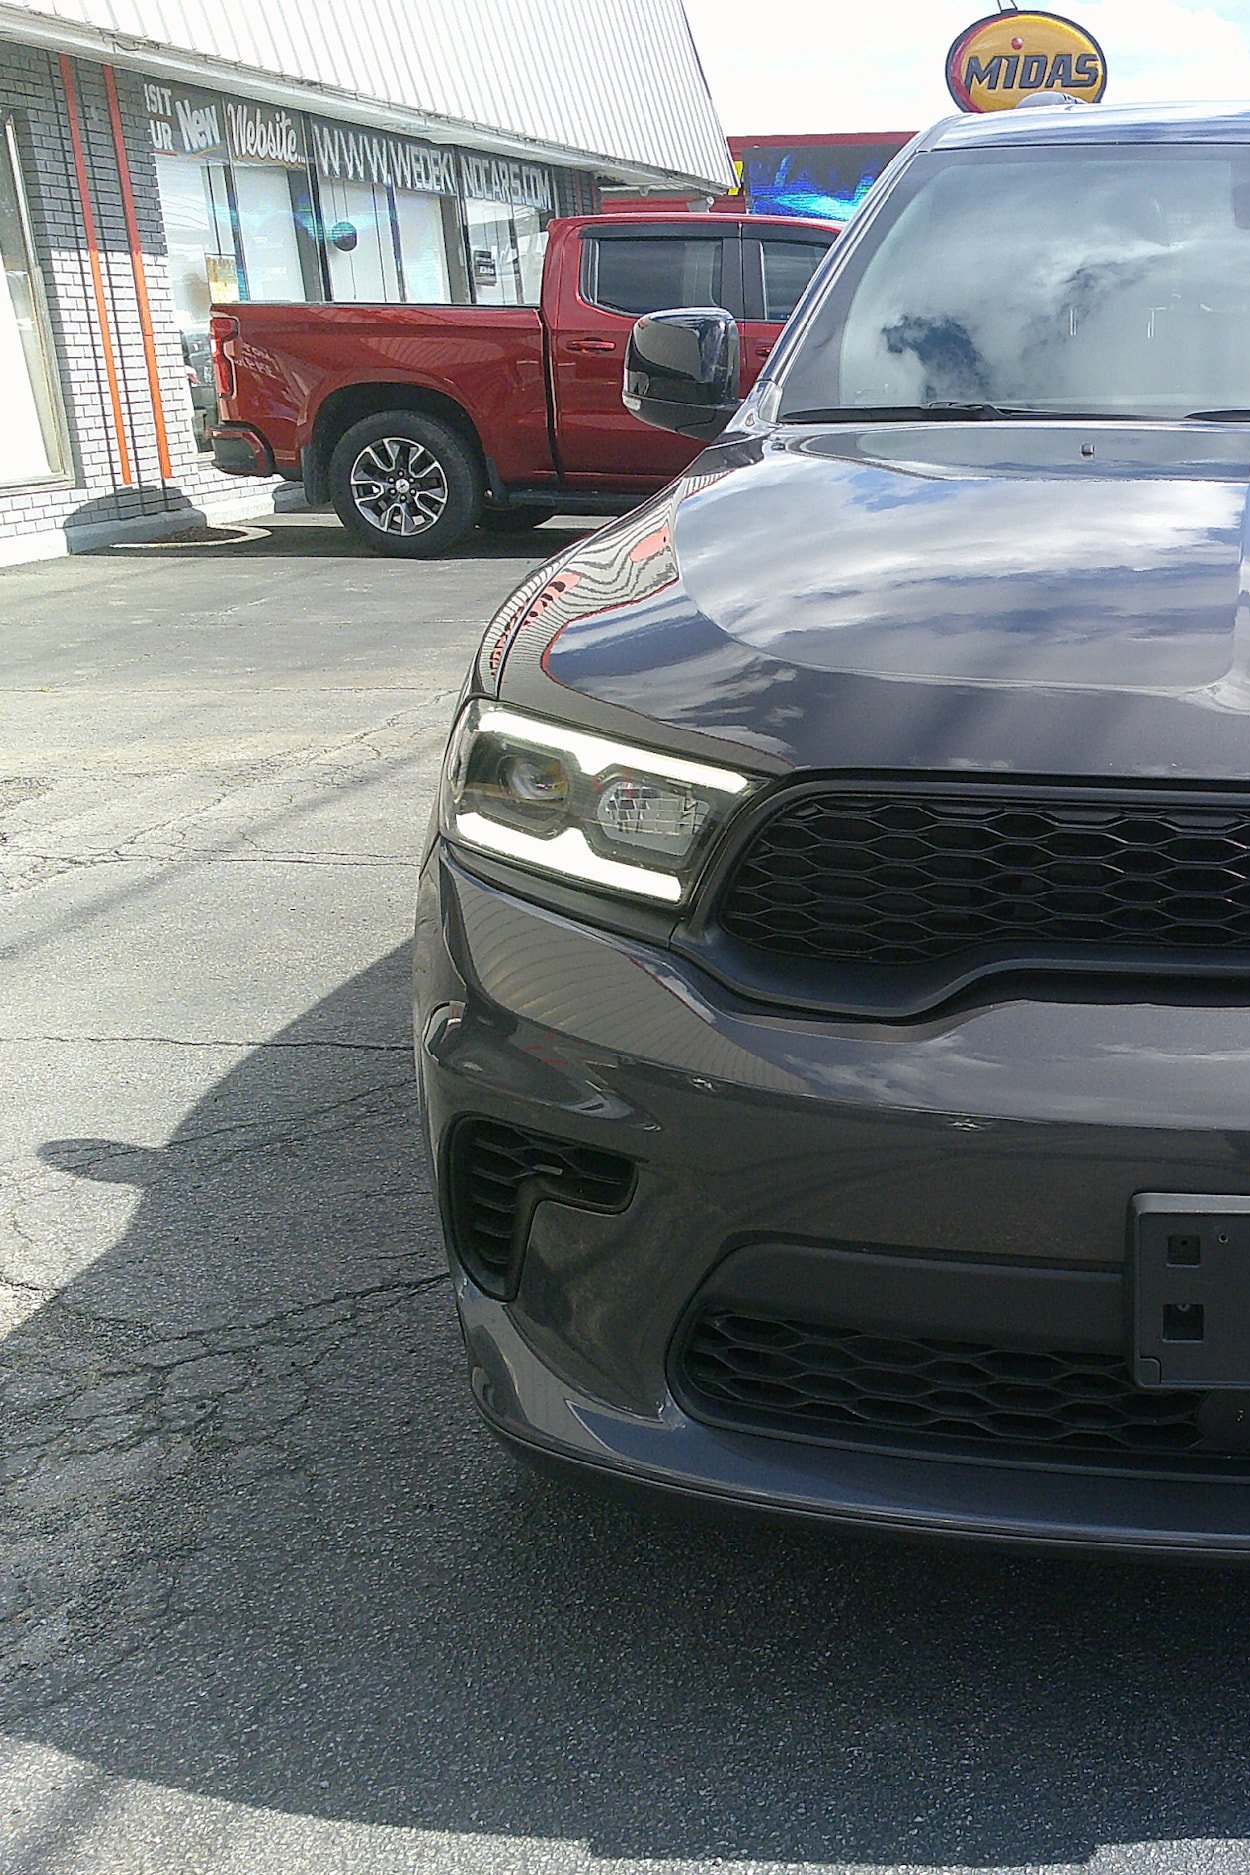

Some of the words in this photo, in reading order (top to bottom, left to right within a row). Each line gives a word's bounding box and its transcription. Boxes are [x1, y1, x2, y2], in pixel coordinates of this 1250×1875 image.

[964, 53, 1099, 94] MIDAS
[143, 83, 172, 116] ISIT
[149, 119, 174, 151] UR
[175, 99, 221, 152] New
